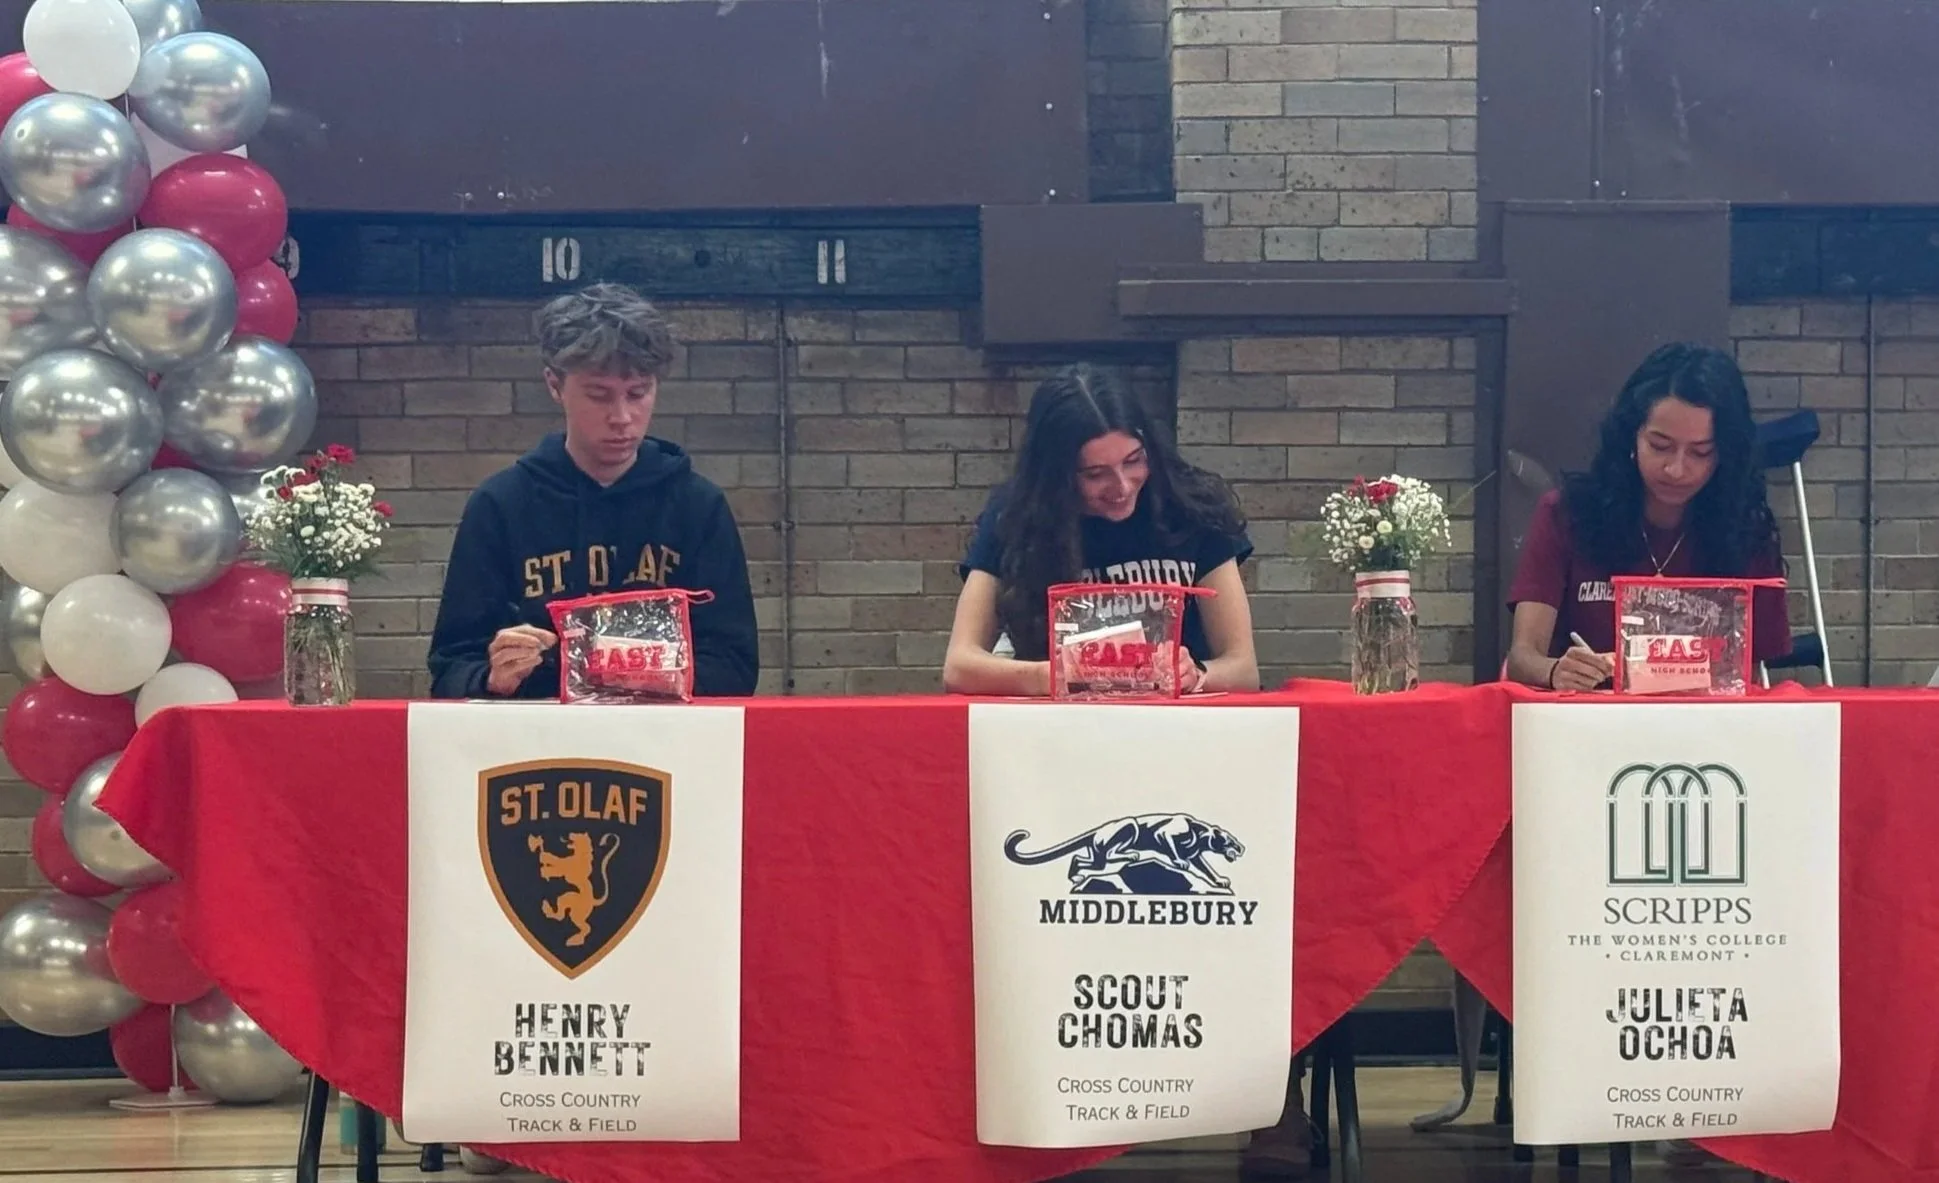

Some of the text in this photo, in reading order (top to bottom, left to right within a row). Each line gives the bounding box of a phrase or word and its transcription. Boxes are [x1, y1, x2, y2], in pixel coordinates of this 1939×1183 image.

[543, 238, 580, 282] 10
[818, 240, 845, 284] 11
[588, 646, 666, 672] EAST
[1080, 642, 1157, 668] EAST
[1647, 636, 1727, 663] EAST
[501, 781, 648, 826] ST. OLAF
[1040, 900, 1258, 925] MIDDLEBURY
[1605, 898, 1751, 924] SCRIPPS
[1568, 935, 1786, 945] THE WOMEN'S COLLEGE
[1620, 951, 1734, 961] CLAREMONT
[1074, 974, 1188, 1010] SCOUT
[1606, 988, 1748, 1023] JULIETA
[516, 1004, 630, 1038] HENRY
[1058, 1013, 1202, 1048] CHOMAS
[1620, 1025, 1736, 1060] OCHOA
[495, 1041, 650, 1076] BENNETT
[1058, 1077, 1193, 1093] CROSS COUNTRY
[1607, 1086, 1743, 1102] CROSS COUNTRY
[500, 1092, 640, 1107] CROSS COUNTRY
[1066, 1104, 1189, 1120] TRACK & FIELD
[507, 1118, 636, 1132] TRACK & FIELD
[1613, 1112, 1737, 1128] TRACK & FIELD
